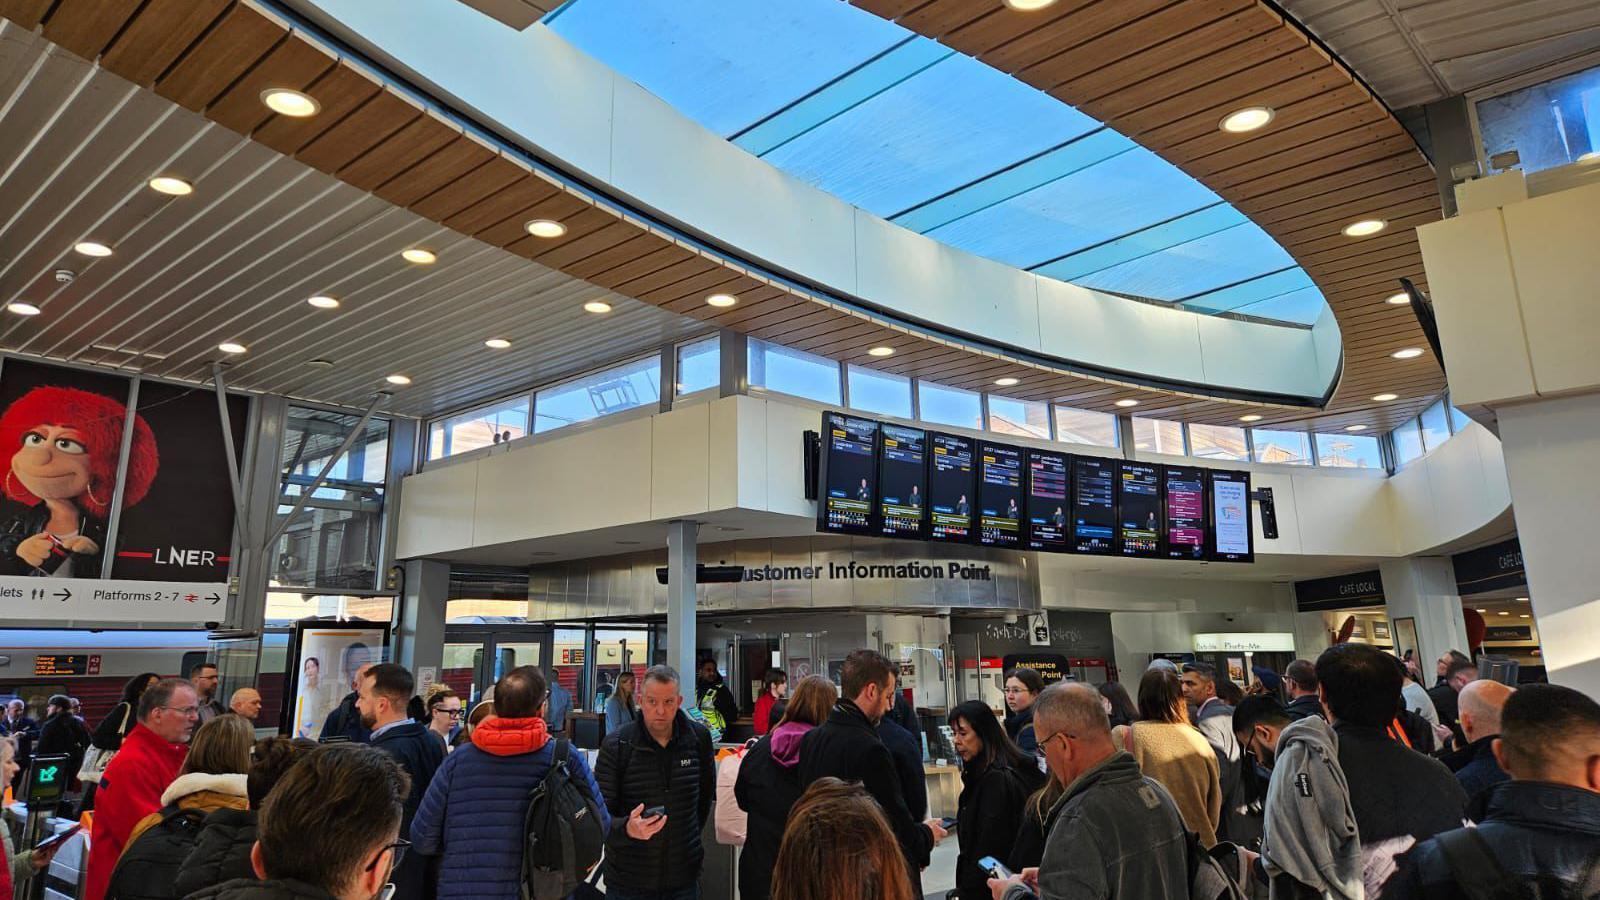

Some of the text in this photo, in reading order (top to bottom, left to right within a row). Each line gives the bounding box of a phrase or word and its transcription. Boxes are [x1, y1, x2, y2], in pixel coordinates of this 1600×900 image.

[155, 546, 215, 568] LNER
[744, 561, 991, 582] ustomer Information Point
[0, 586, 24, 598] lets
[94, 589, 152, 602] Platforms
[154, 592, 162, 601] 2
[172, 592, 180, 602] 7
[1015, 661, 1057, 670] Assistance
[1041, 671, 1062, 679] Point
